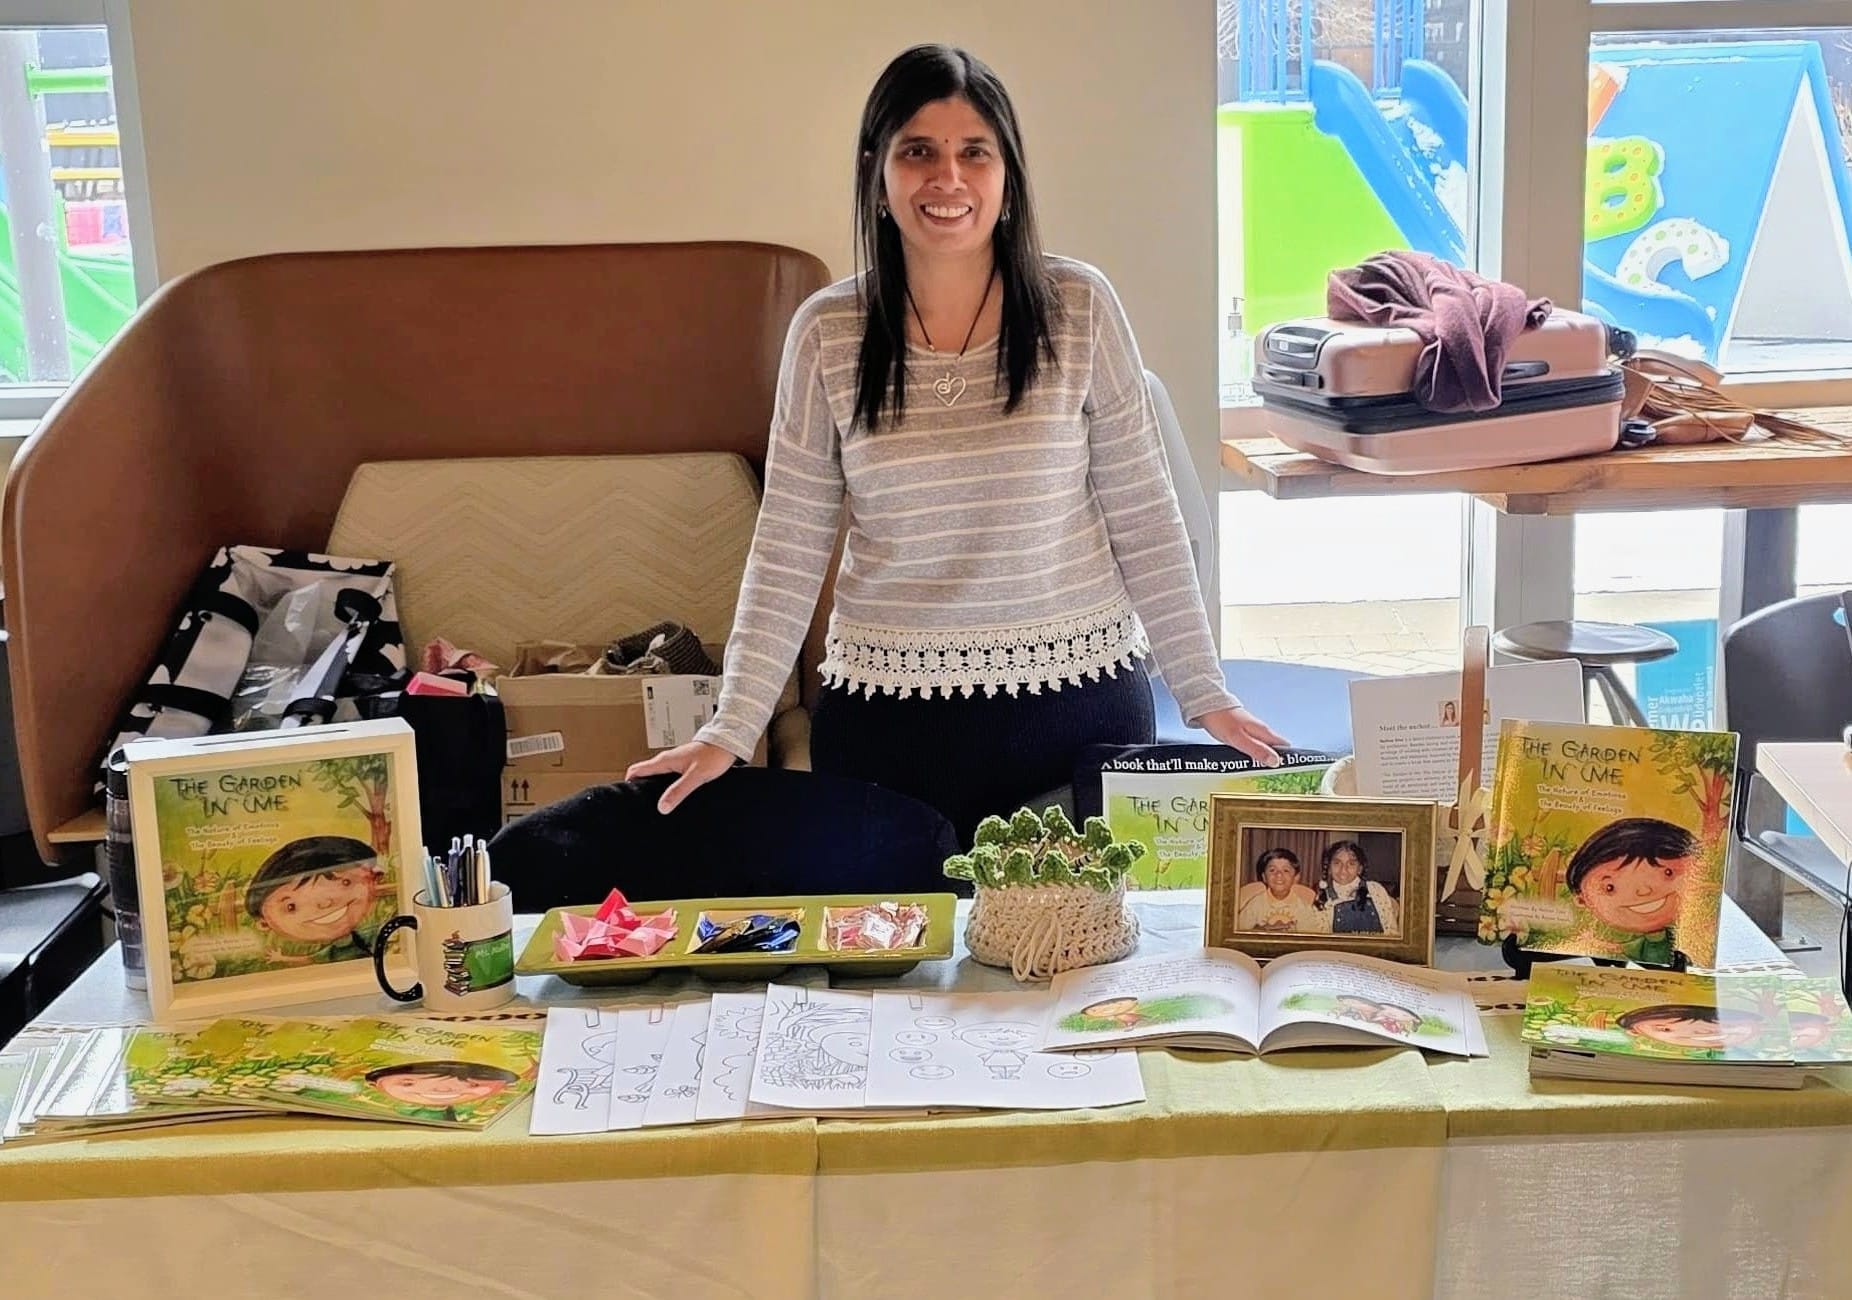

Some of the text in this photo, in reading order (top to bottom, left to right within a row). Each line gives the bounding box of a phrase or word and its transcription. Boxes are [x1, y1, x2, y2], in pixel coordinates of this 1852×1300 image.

[1517, 736, 1640, 764] THE GARDEN
[1113, 758, 1144, 771] book
[1146, 758, 1182, 771] that'll
[1185, 758, 1218, 770] make
[1219, 759, 1250, 773] your
[1541, 758, 1625, 786] IN ME
[169, 774, 302, 800] THE GARDEN
[200, 792, 289, 819] IN ME
[1126, 796, 1161, 817] THE
